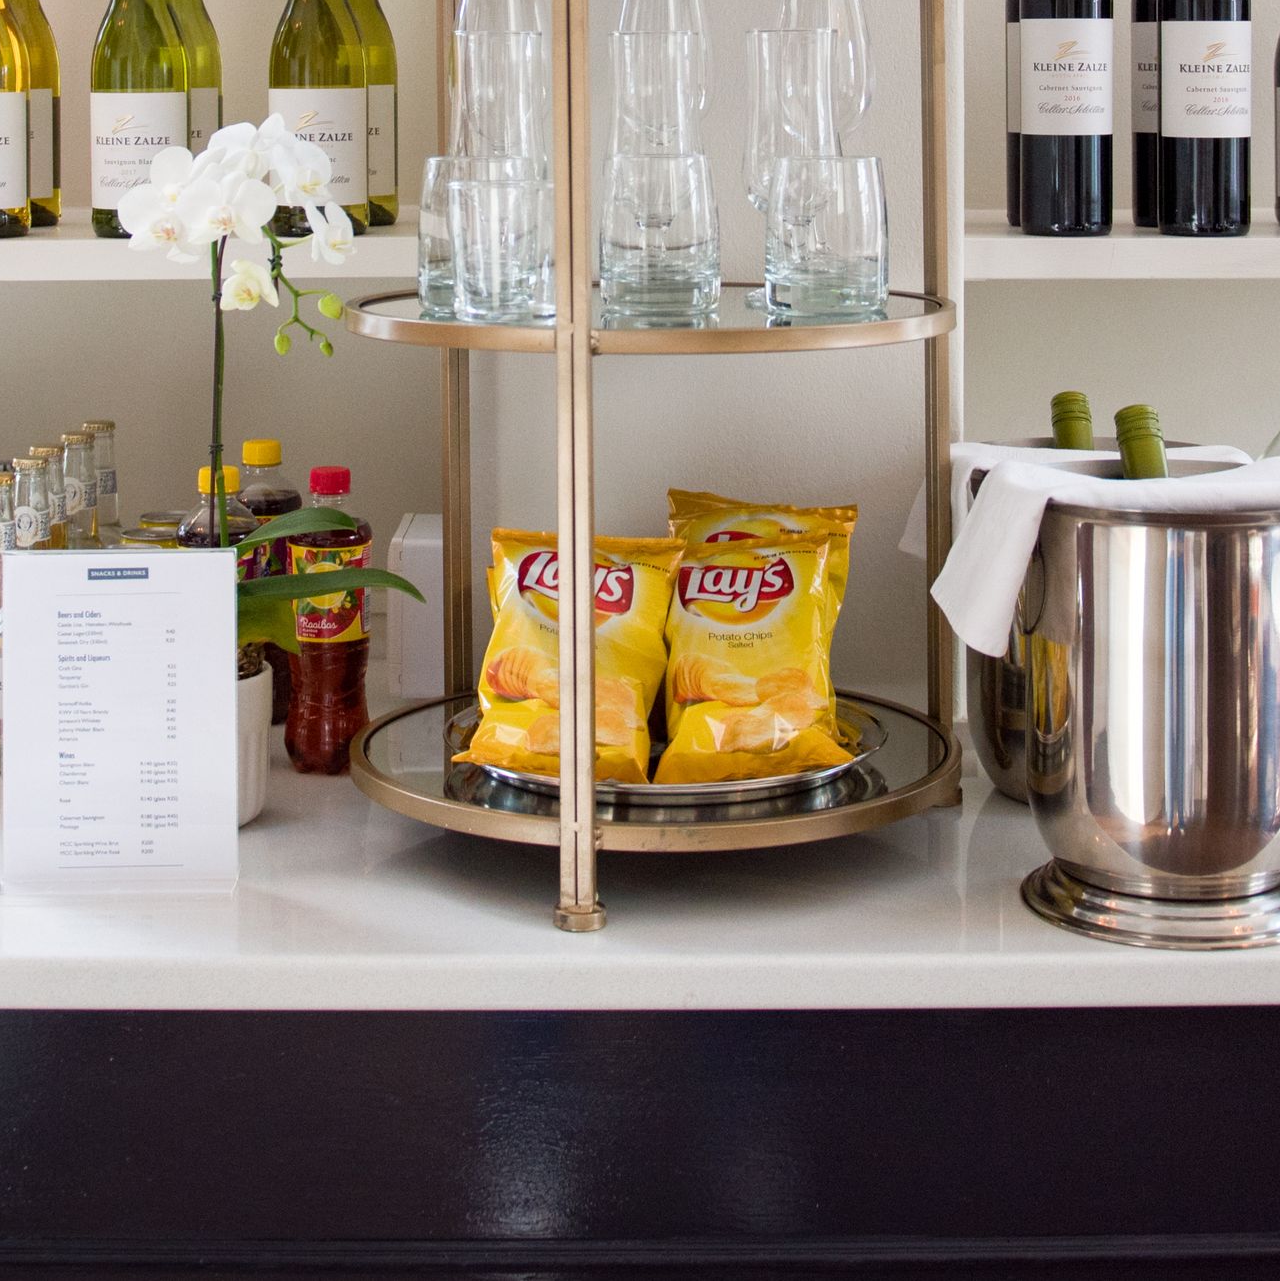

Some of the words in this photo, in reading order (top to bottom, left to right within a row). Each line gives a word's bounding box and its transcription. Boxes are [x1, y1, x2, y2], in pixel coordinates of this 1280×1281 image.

[1033, 62, 1075, 72] KLEINE
[1077, 62, 1108, 72] ZALZE
[1137, 62, 1158, 72] KLEI
[1179, 63, 1223, 73] KLEINE
[1225, 63, 1250, 73] ZALZE
[96, 136, 131, 146] KLEINE
[134, 136, 171, 145] ZALZE
[318, 132, 353, 142] ZALZE
[685, 564, 786, 613] Lay's
[57, 610, 72, 619] Beers
[73, 610, 84, 619] and
[85, 610, 102, 619] Ciders
[300, 617, 338, 630] Rooibos
[708, 632, 742, 641] Potato
[744, 631, 773, 641] Chips
[728, 641, 754, 649] Salted
[58, 654, 75, 663] Spirits
[76, 654, 87, 662] and
[87, 654, 111, 663] Liqueurs
[58, 751, 75, 759] Wines
